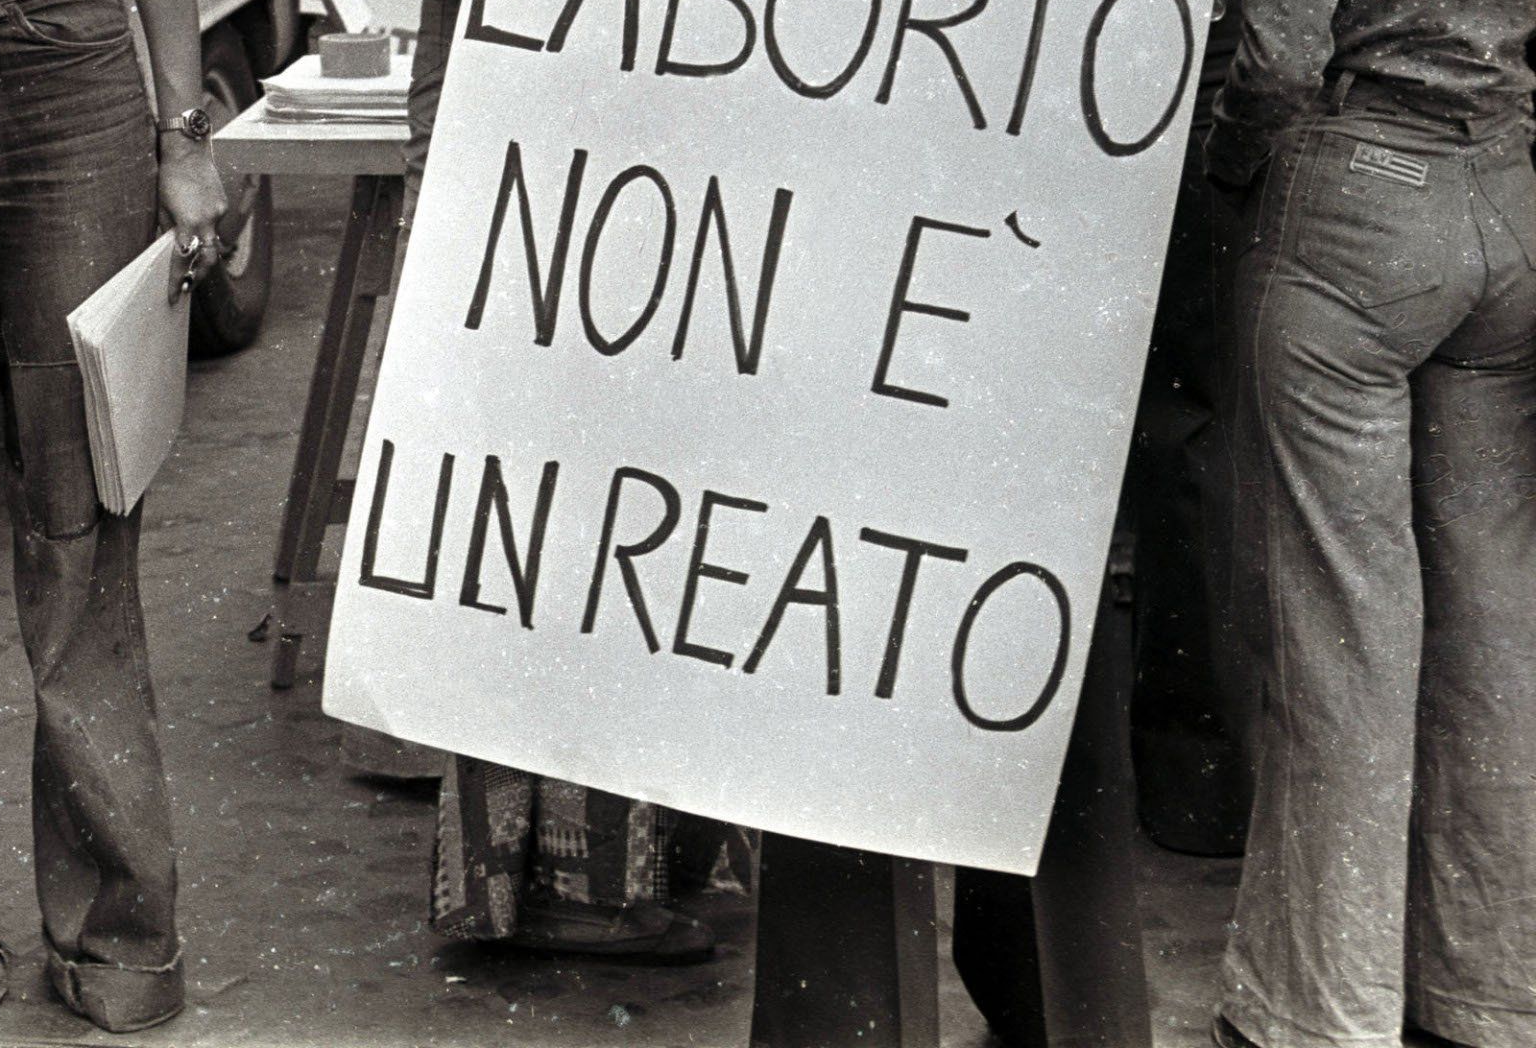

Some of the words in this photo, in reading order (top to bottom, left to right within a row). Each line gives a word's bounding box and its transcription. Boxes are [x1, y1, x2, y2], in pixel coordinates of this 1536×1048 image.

[463, 140, 794, 376] NON
[359, 439, 560, 630] UN
[580, 466, 1071, 733] REATO
